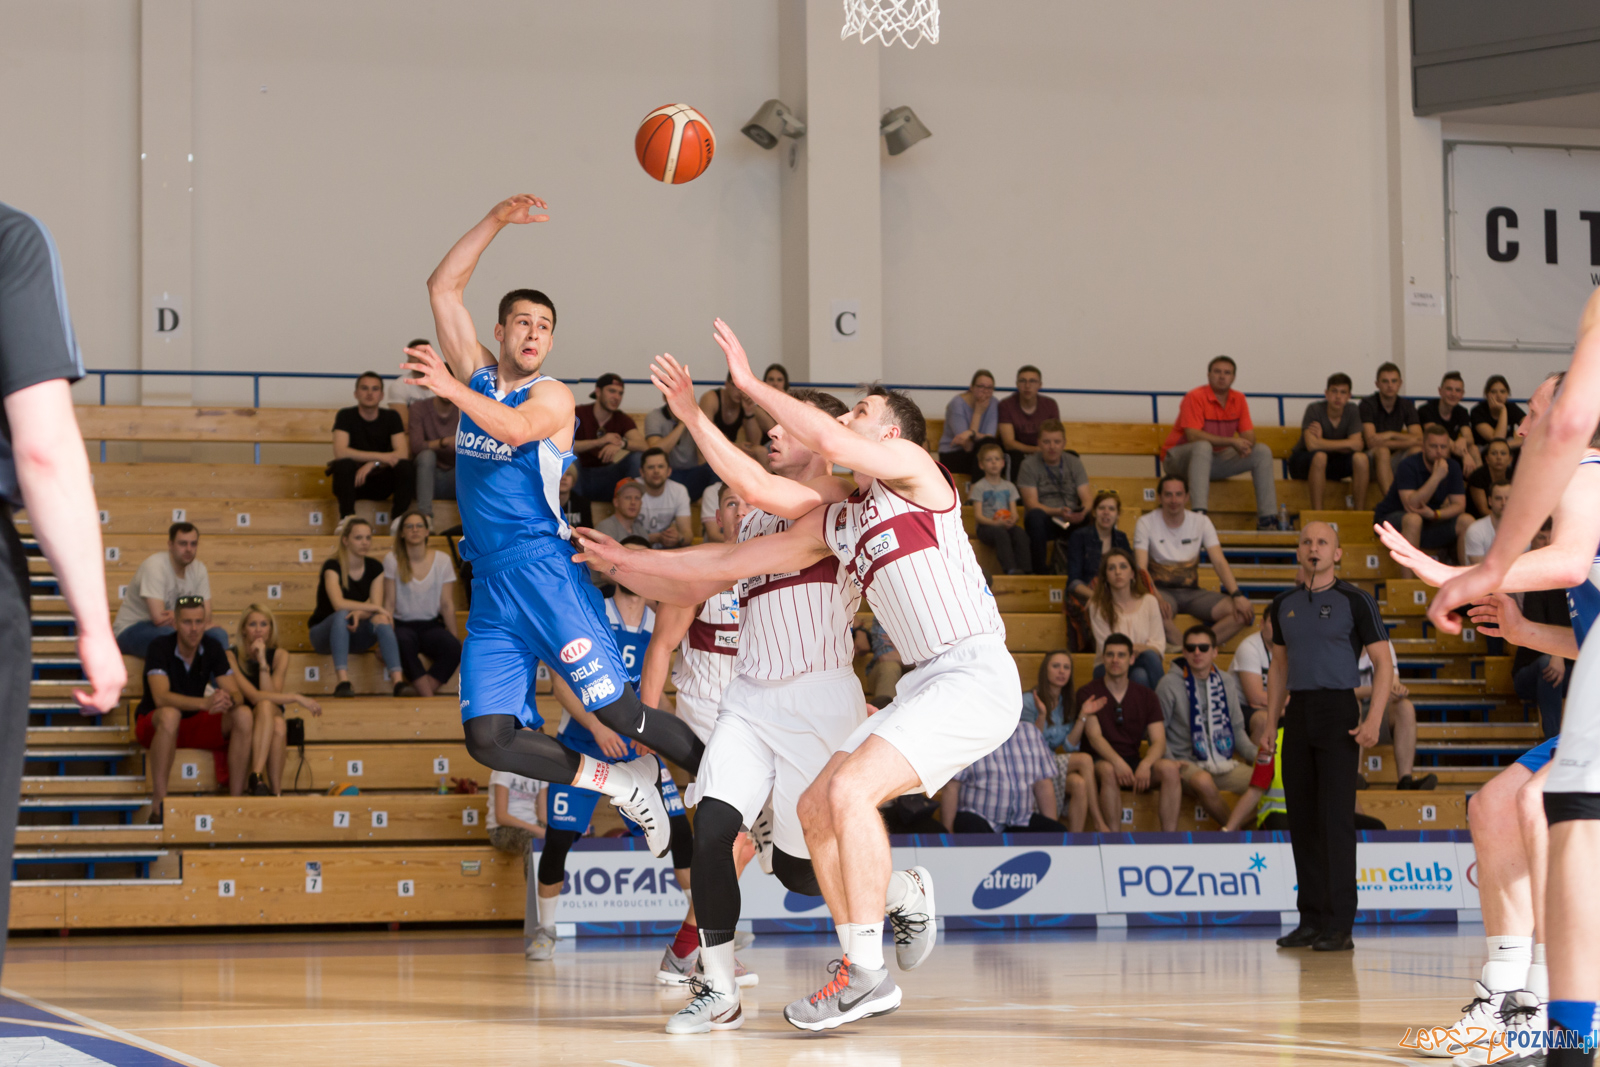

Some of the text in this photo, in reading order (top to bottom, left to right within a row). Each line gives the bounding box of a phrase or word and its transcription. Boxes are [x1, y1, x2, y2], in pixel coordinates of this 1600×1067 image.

[1486, 206, 1600, 266] CIT
[156, 307, 179, 332] D
[835, 312, 857, 336] C
[177, 510, 182, 520] 7
[860, 495, 879, 527] 25
[871, 541, 889, 556] ZZO
[562, 642, 587, 661] KIA
[622, 644, 636, 669] 6
[540, 668, 546, 678] 3
[570, 657, 603, 682] DELIK
[587, 678, 616, 703] PBG
[186, 765, 193, 777] 8
[352, 762, 359, 774] 6
[438, 760, 445, 772] 5
[553, 792, 569, 815] 6
[467, 811, 474, 823] 5
[1426, 807, 1433, 818] 9
[200, 817, 207, 829] 8
[338, 813, 345, 825] 7
[376, 813, 383, 825] 6
[1356, 861, 1453, 882] unclub
[311, 878, 318, 890] 7
[559, 867, 683, 896] BIOFAR
[983, 871, 1037, 889] atrem
[223, 882, 231, 894] 8
[402, 882, 410, 894] 6
[604, 899, 662, 908] PRODUCENT
[669, 899, 686, 907] LEK
